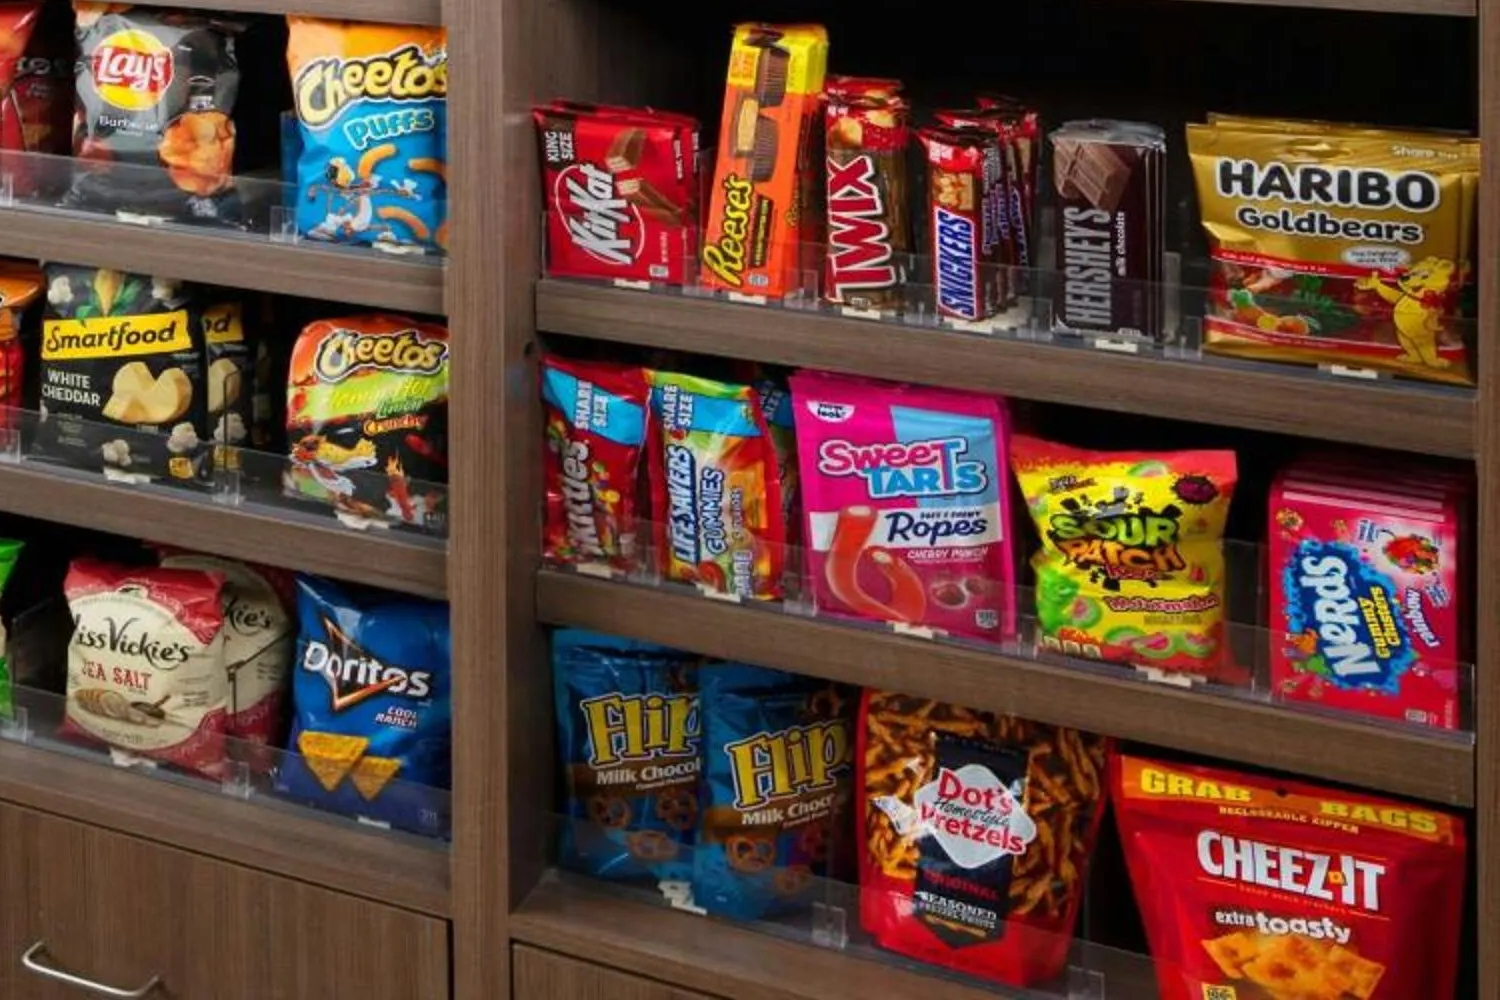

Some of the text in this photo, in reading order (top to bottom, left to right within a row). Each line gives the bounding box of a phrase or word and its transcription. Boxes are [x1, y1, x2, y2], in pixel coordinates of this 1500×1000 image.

[98, 47, 164, 91] Lay's
[298, 46, 447, 126] Cheetos
[1218, 161, 1438, 211] HARIBO
[703, 172, 754, 286] Reese's
[825, 156, 897, 303] TWIX
[1237, 207, 1422, 242] Goldbears
[938, 209, 976, 318] SNICKERS
[1063, 205, 1112, 326] HERSHEY'S
[46, 320, 178, 351] Smartfood
[319, 331, 447, 378] Cheetos
[41, 384, 100, 406] CHEDDAR
[47, 368, 91, 389] WHITE
[575, 380, 593, 430] SHARE
[593, 395, 609, 427] SIZE
[664, 385, 678, 430] SHARE
[678, 392, 693, 427] SIZE
[701, 467, 728, 555] GUMMIES
[885, 511, 987, 546] Ropes
[1051, 513, 1180, 548] SOUR
[1057, 538, 1187, 573] PATCH
[105, 616, 191, 670] Vickie's
[112, 667, 154, 690] SALT
[303, 640, 431, 698] Doritos
[596, 766, 637, 786] Milk
[937, 768, 1013, 815] Dot's
[741, 807, 784, 826] Milk
[1140, 767, 1439, 834] GRAB BAGS
[920, 803, 1025, 854] Pretzels
[917, 890, 997, 920] SEASONED
[1215, 910, 1350, 944] extra toasty
